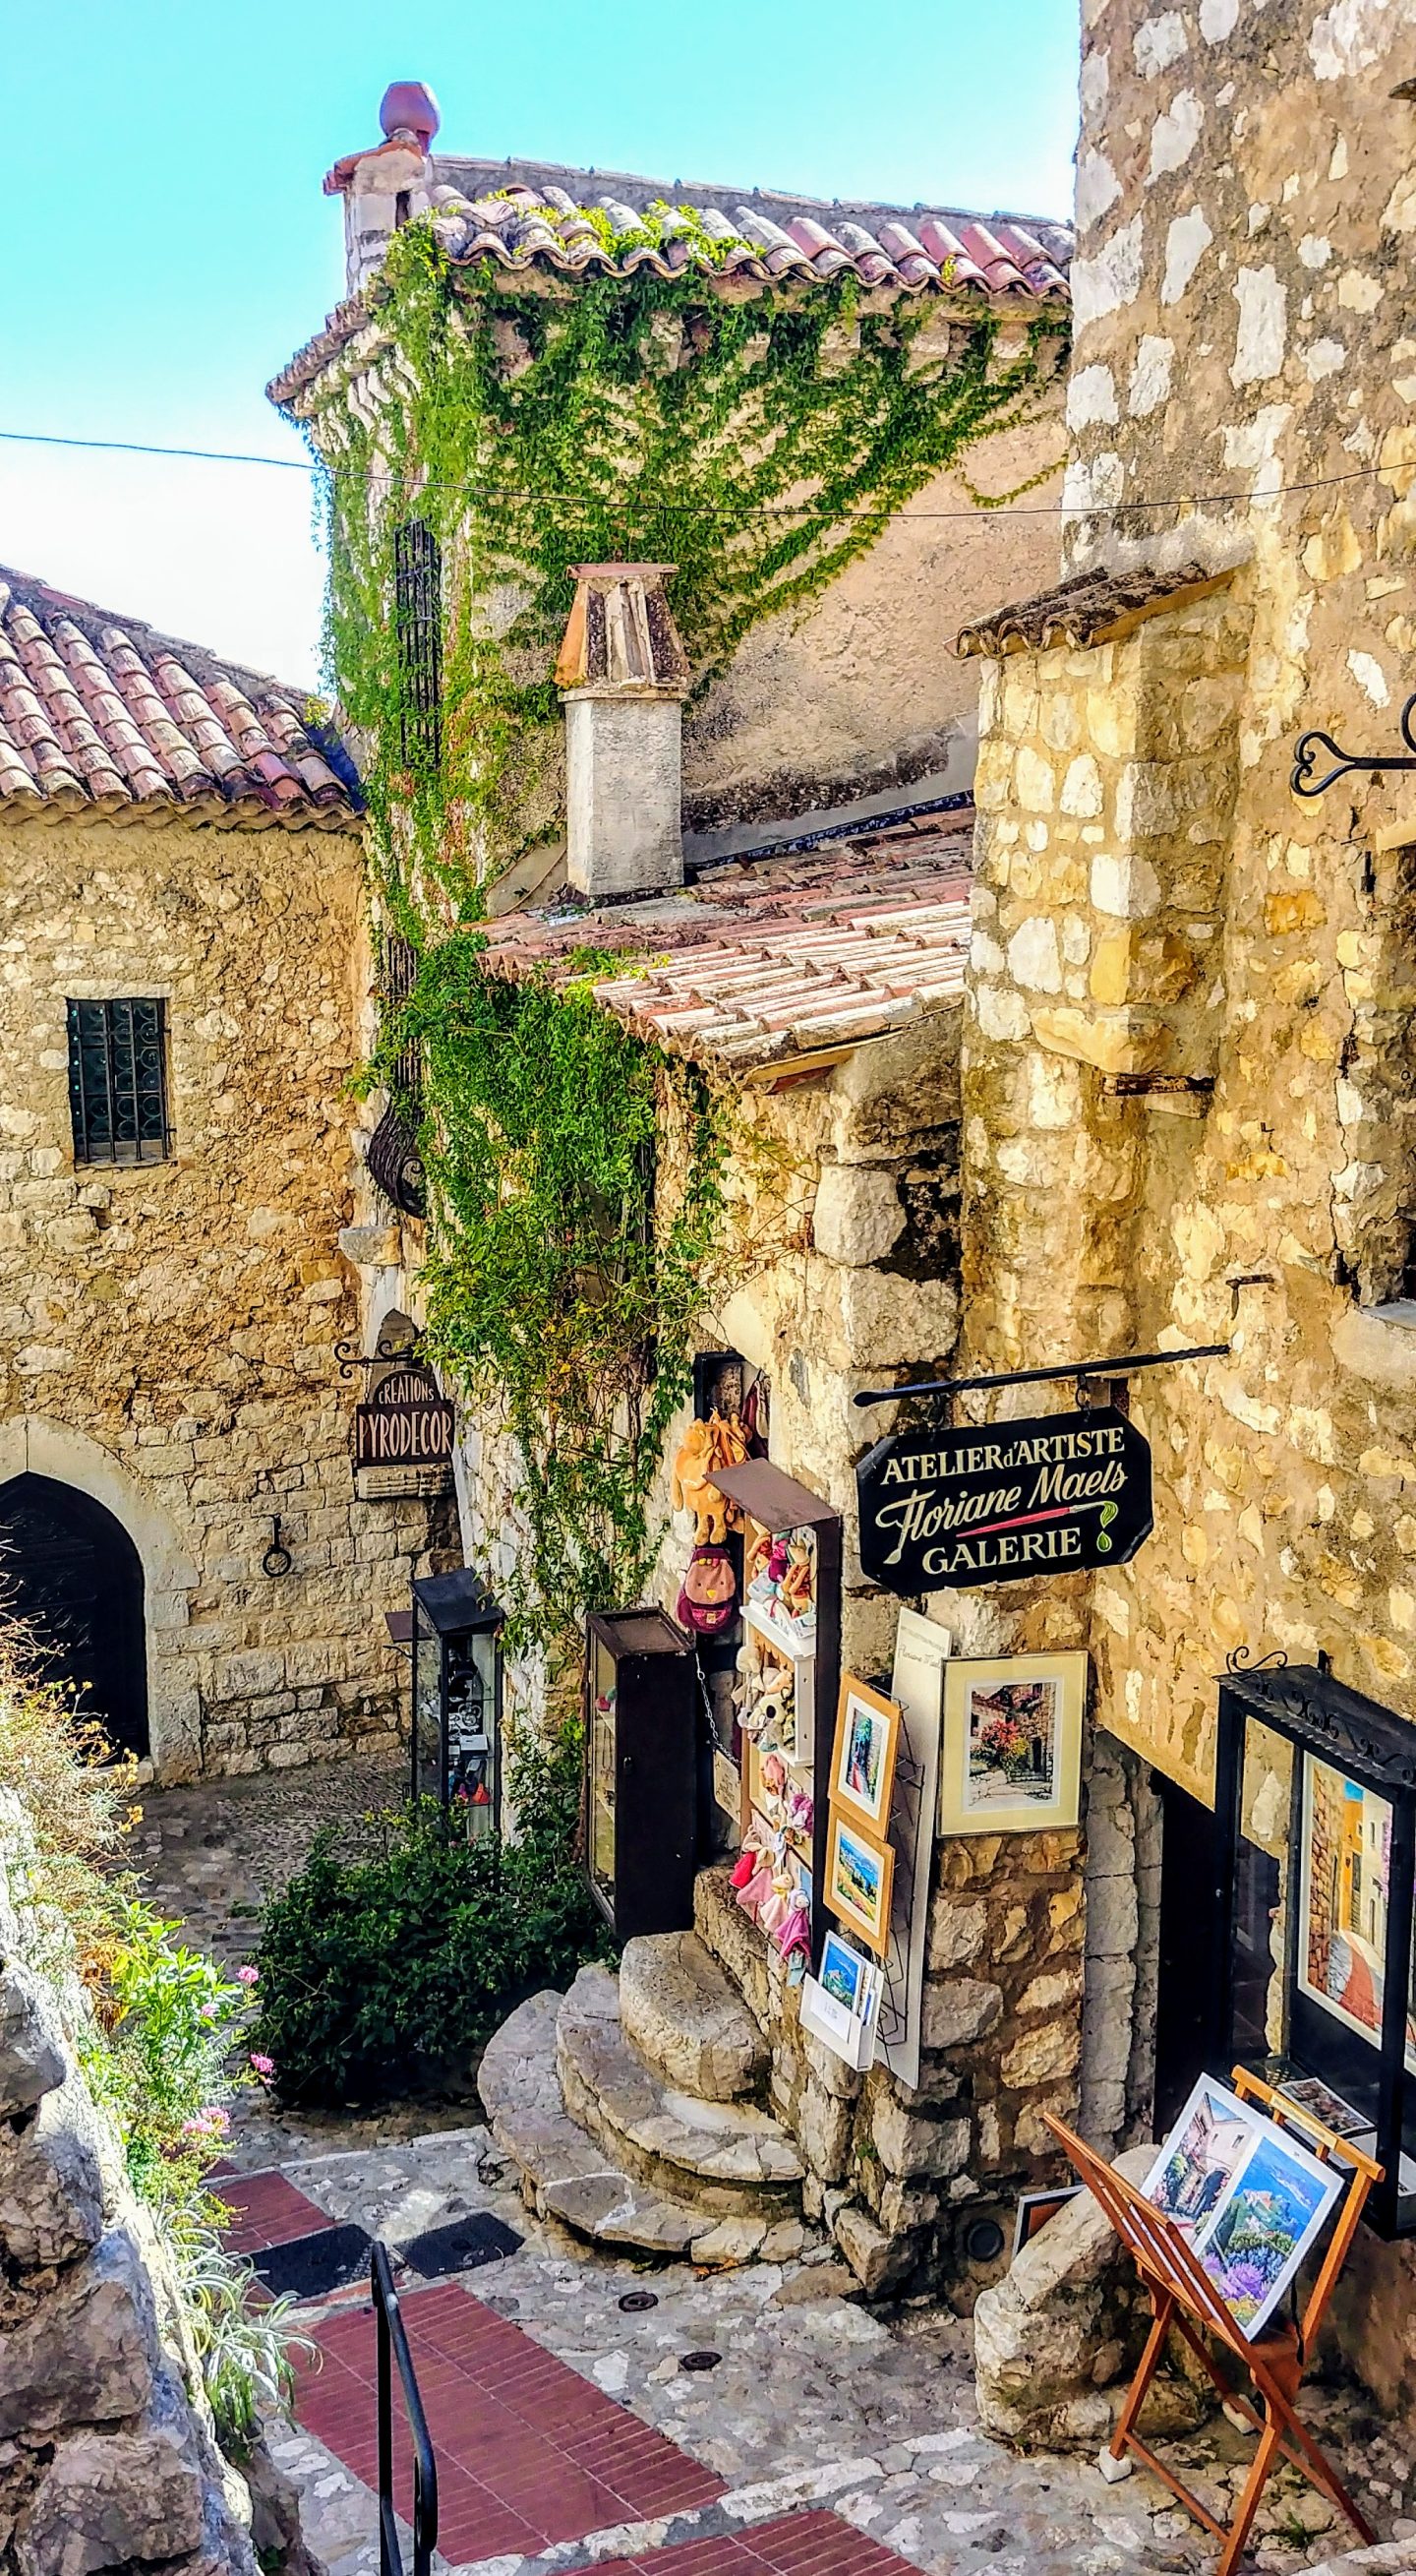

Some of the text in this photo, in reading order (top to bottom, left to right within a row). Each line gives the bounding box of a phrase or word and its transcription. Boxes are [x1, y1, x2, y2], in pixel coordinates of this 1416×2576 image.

[379, 1376, 435, 1404] CREATIONS
[359, 1410, 452, 1459] PYRODECOR
[880, 1427, 1126, 1485] ATELIER d'ARTISTE
[875, 1461, 1128, 1565] Floriane Maels
[922, 1527, 1082, 1575] GALERIE
